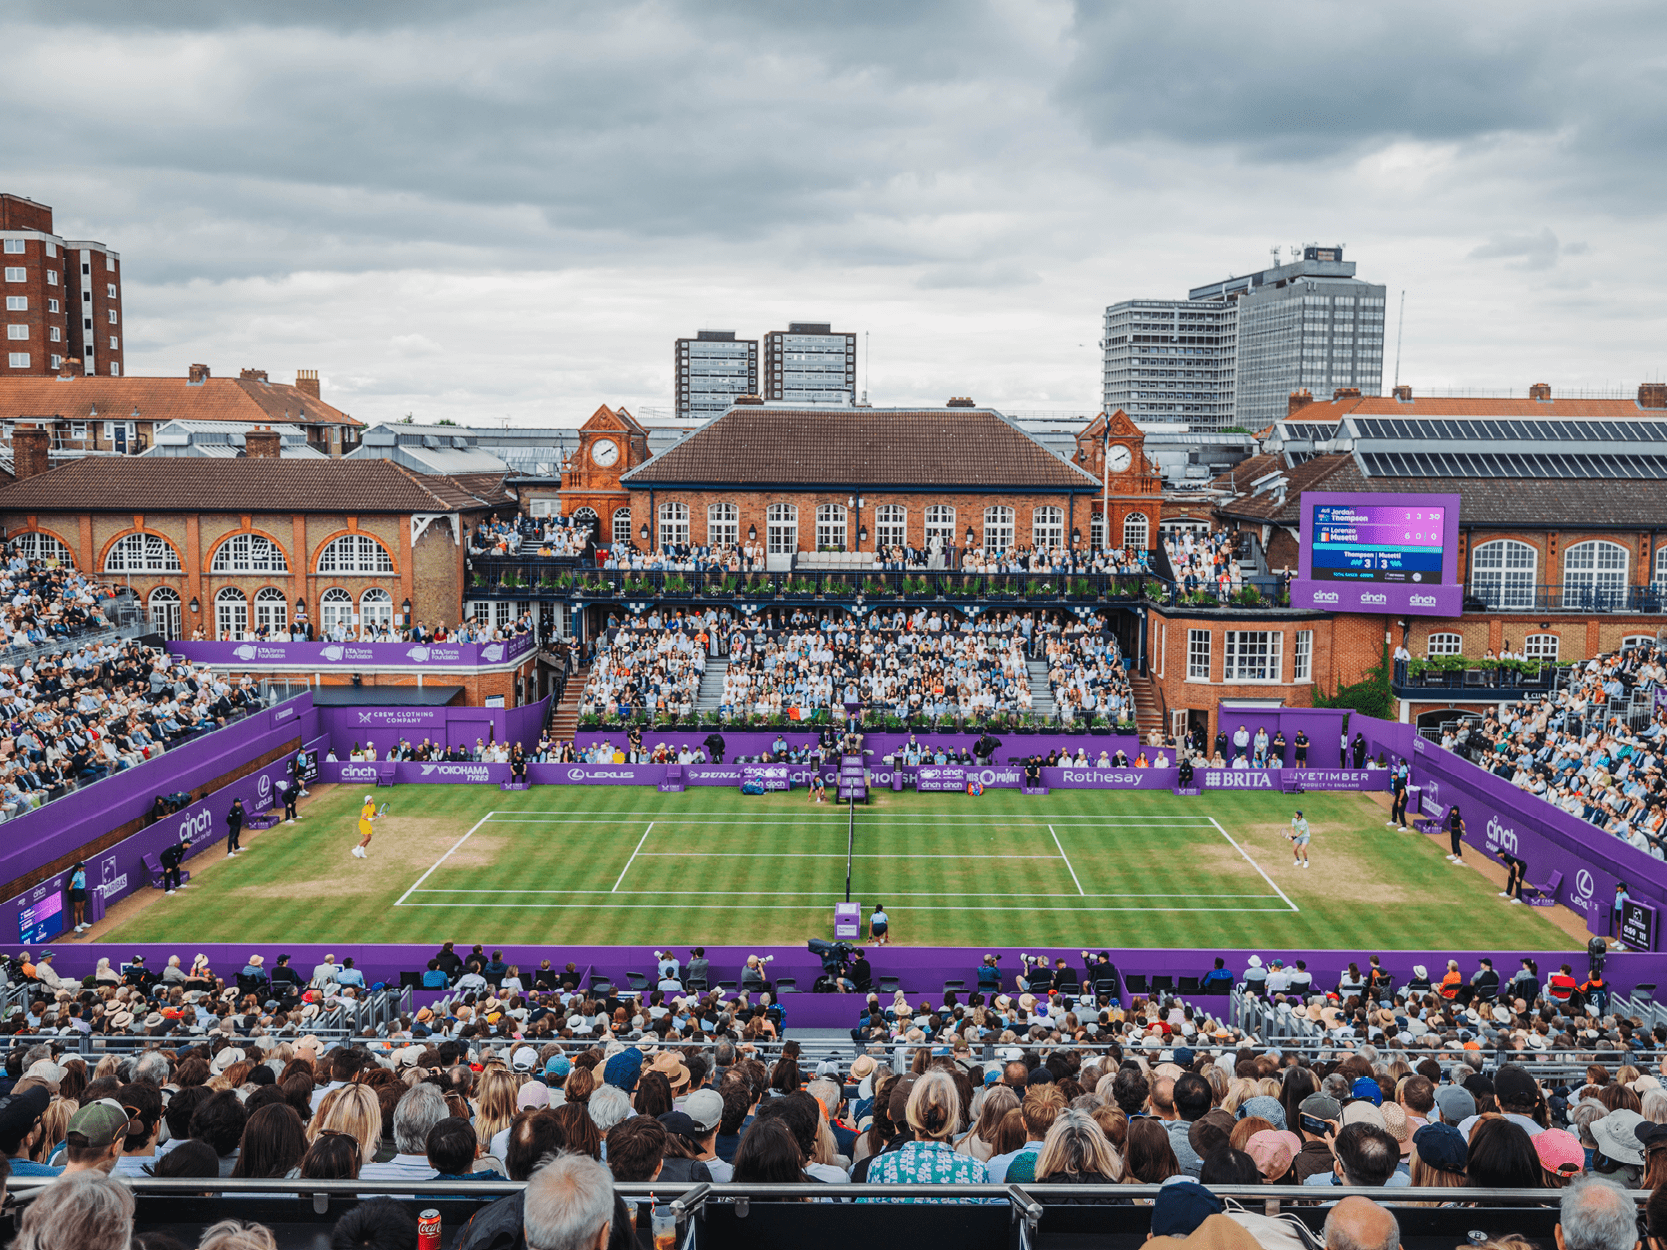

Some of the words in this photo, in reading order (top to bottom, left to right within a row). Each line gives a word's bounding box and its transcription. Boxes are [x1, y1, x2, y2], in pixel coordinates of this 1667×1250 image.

[1364, 559, 1371, 568] 3
[1381, 559, 1388, 569] 3
[1314, 590, 1339, 600] cinch
[1361, 592, 1386, 602] cinch
[1410, 594, 1436, 604] cinch
[342, 764, 376, 776] cinch
[437, 766, 489, 775] YOKOHAMA
[943, 768, 963, 776] cinch
[1063, 771, 1143, 786] Rothesay
[1223, 772, 1272, 786] BRITA
[922, 780, 941, 788] cinch
[256, 794, 273, 810] LEXUS
[180, 808, 212, 841] cinch
[1486, 815, 1518, 855] cinch
